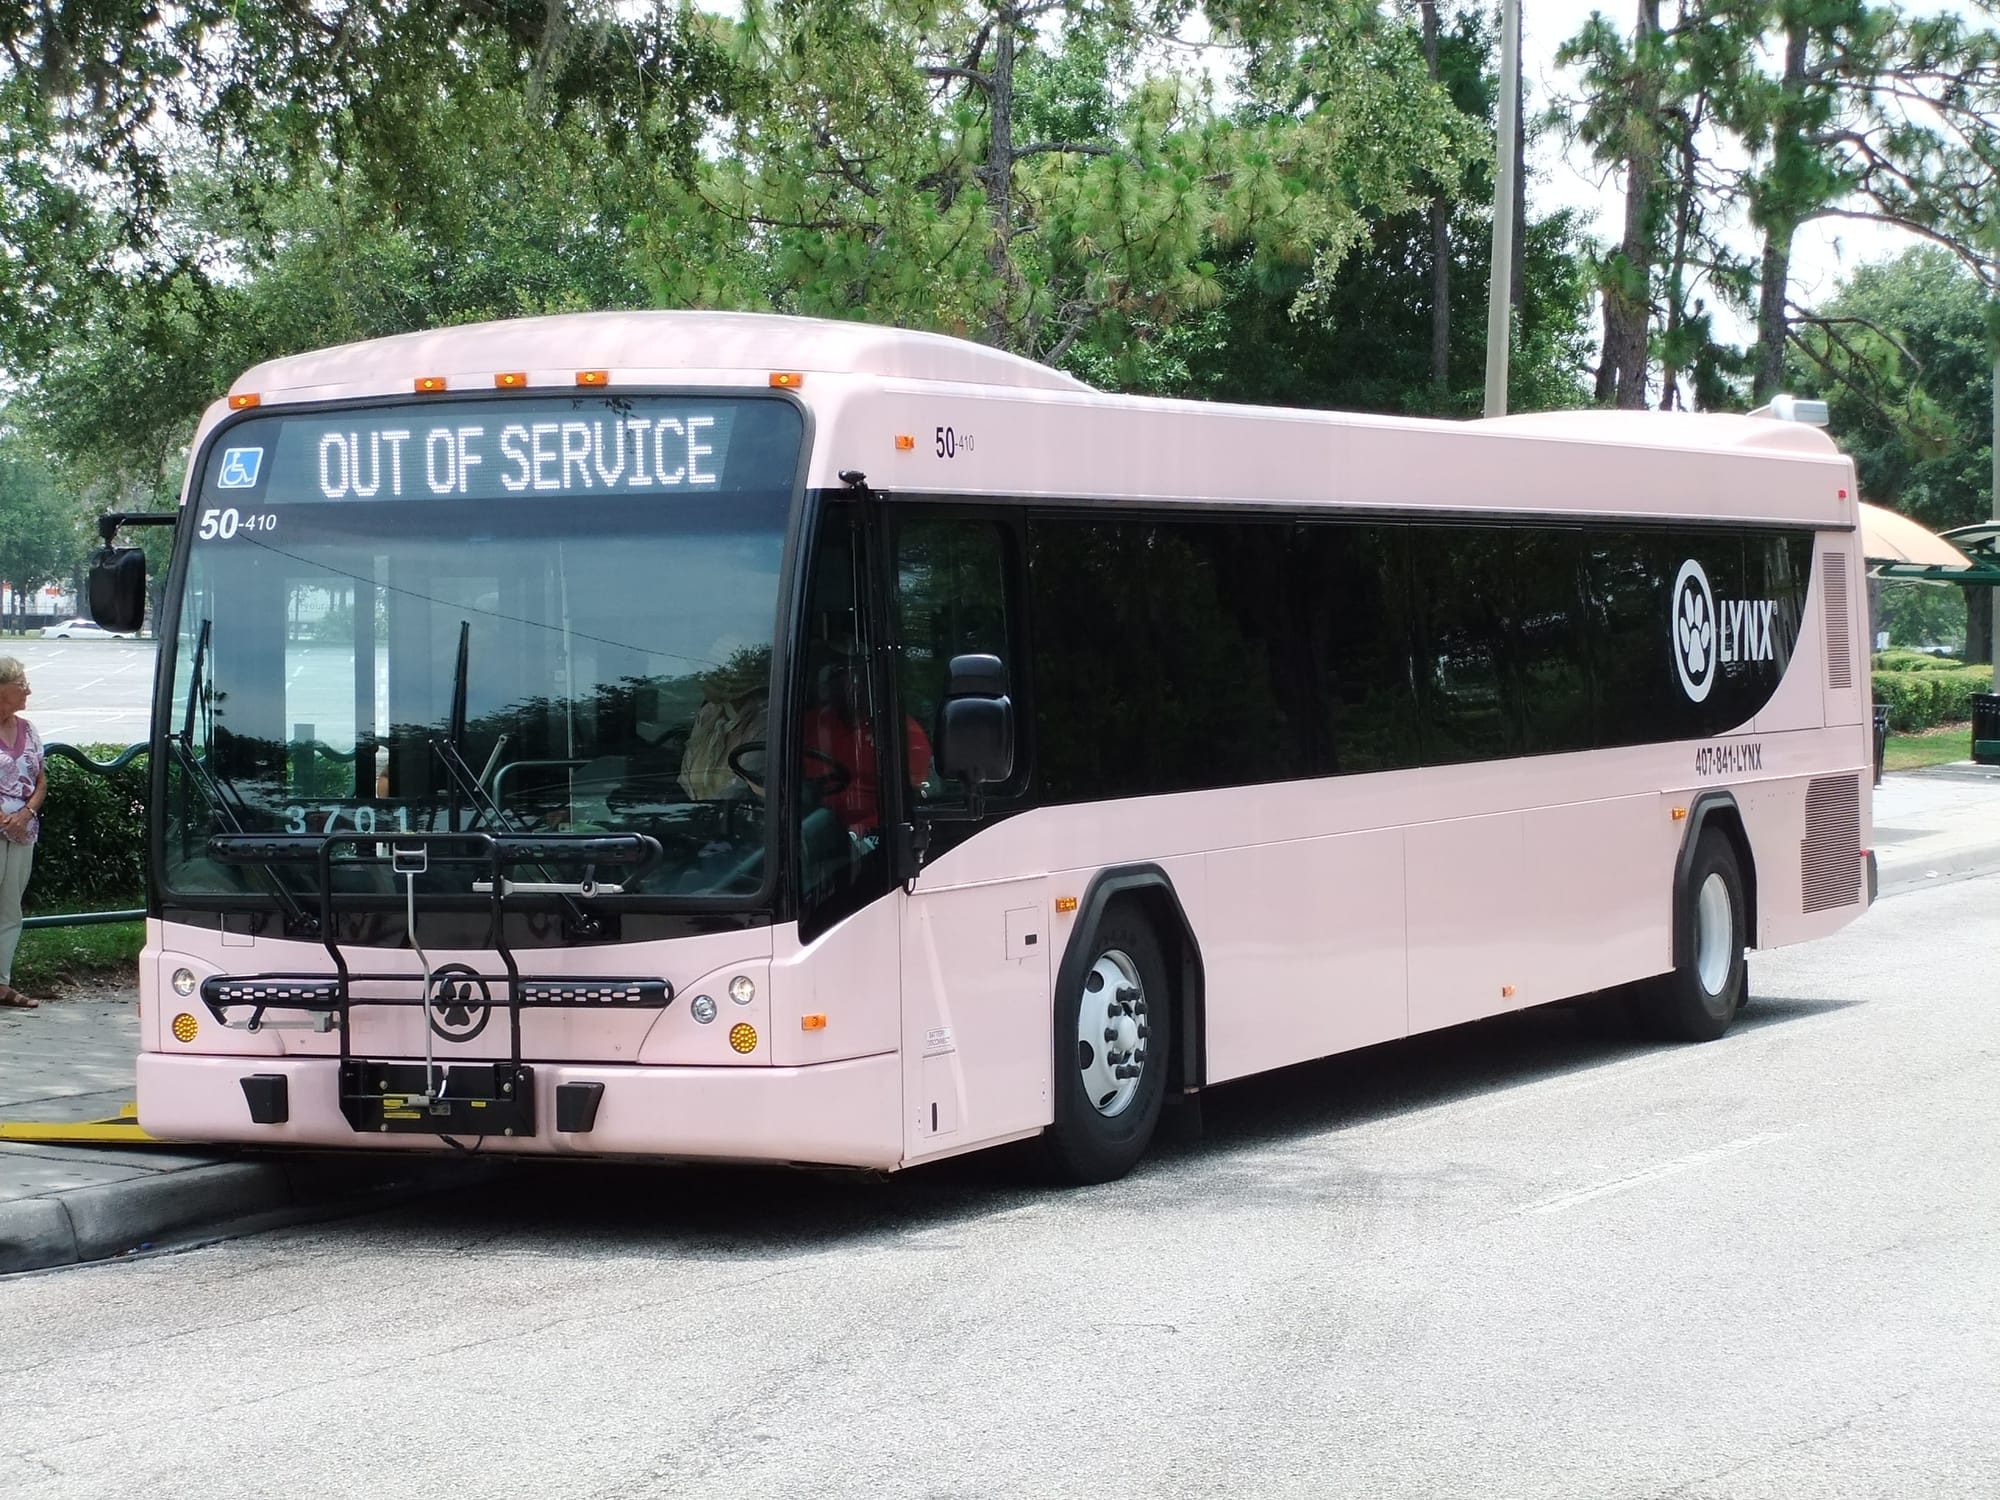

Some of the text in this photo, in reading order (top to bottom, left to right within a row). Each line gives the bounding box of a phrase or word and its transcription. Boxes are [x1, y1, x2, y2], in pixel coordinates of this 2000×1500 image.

[320, 416, 716, 498] OUT OF SERVICE
[935, 426, 975, 458] 50-410
[199, 508, 277, 540] 50-410
[1720, 600, 1774, 661] LYNX
[1695, 743, 1762, 776] 407-841-LYNX
[284, 804, 408, 834] 3701
